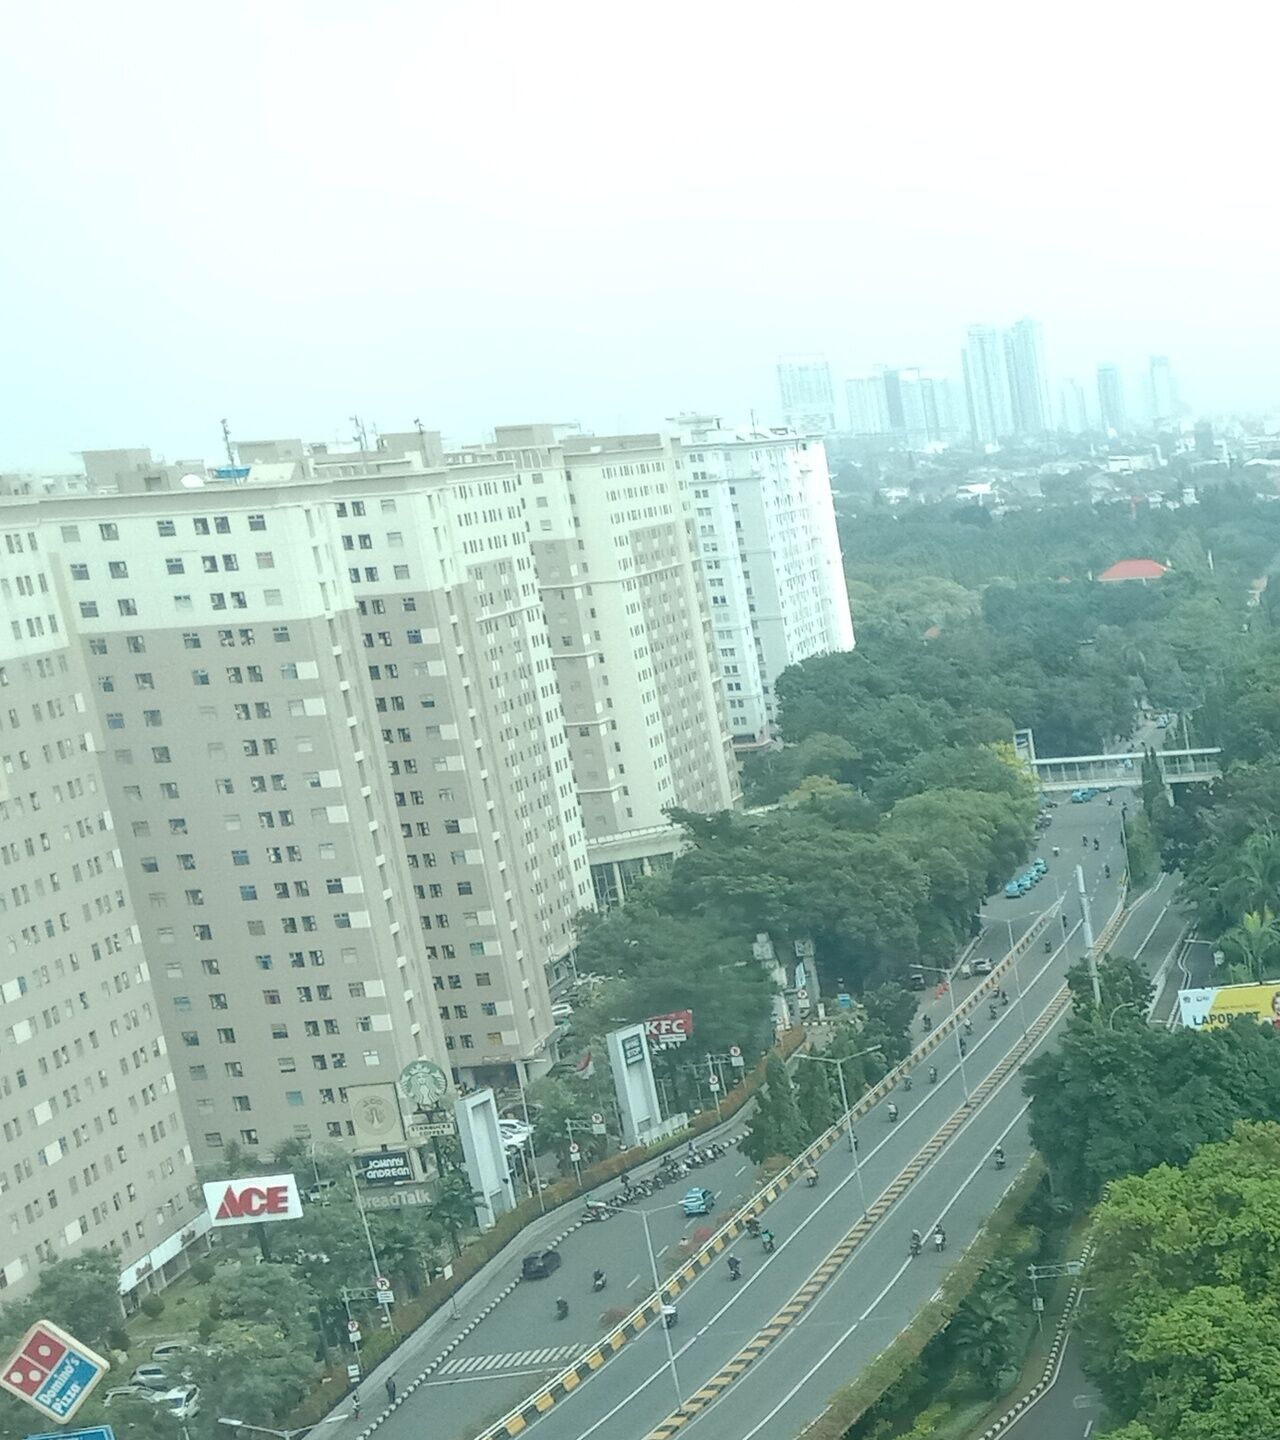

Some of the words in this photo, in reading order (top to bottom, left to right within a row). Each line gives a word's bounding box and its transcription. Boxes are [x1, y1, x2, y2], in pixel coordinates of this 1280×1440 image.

[645, 1019, 685, 1035] KFC
[215, 1184, 288, 1220] ACE
[38, 1357, 80, 1405] Domino's
[51, 1383, 82, 1414] Pizza
